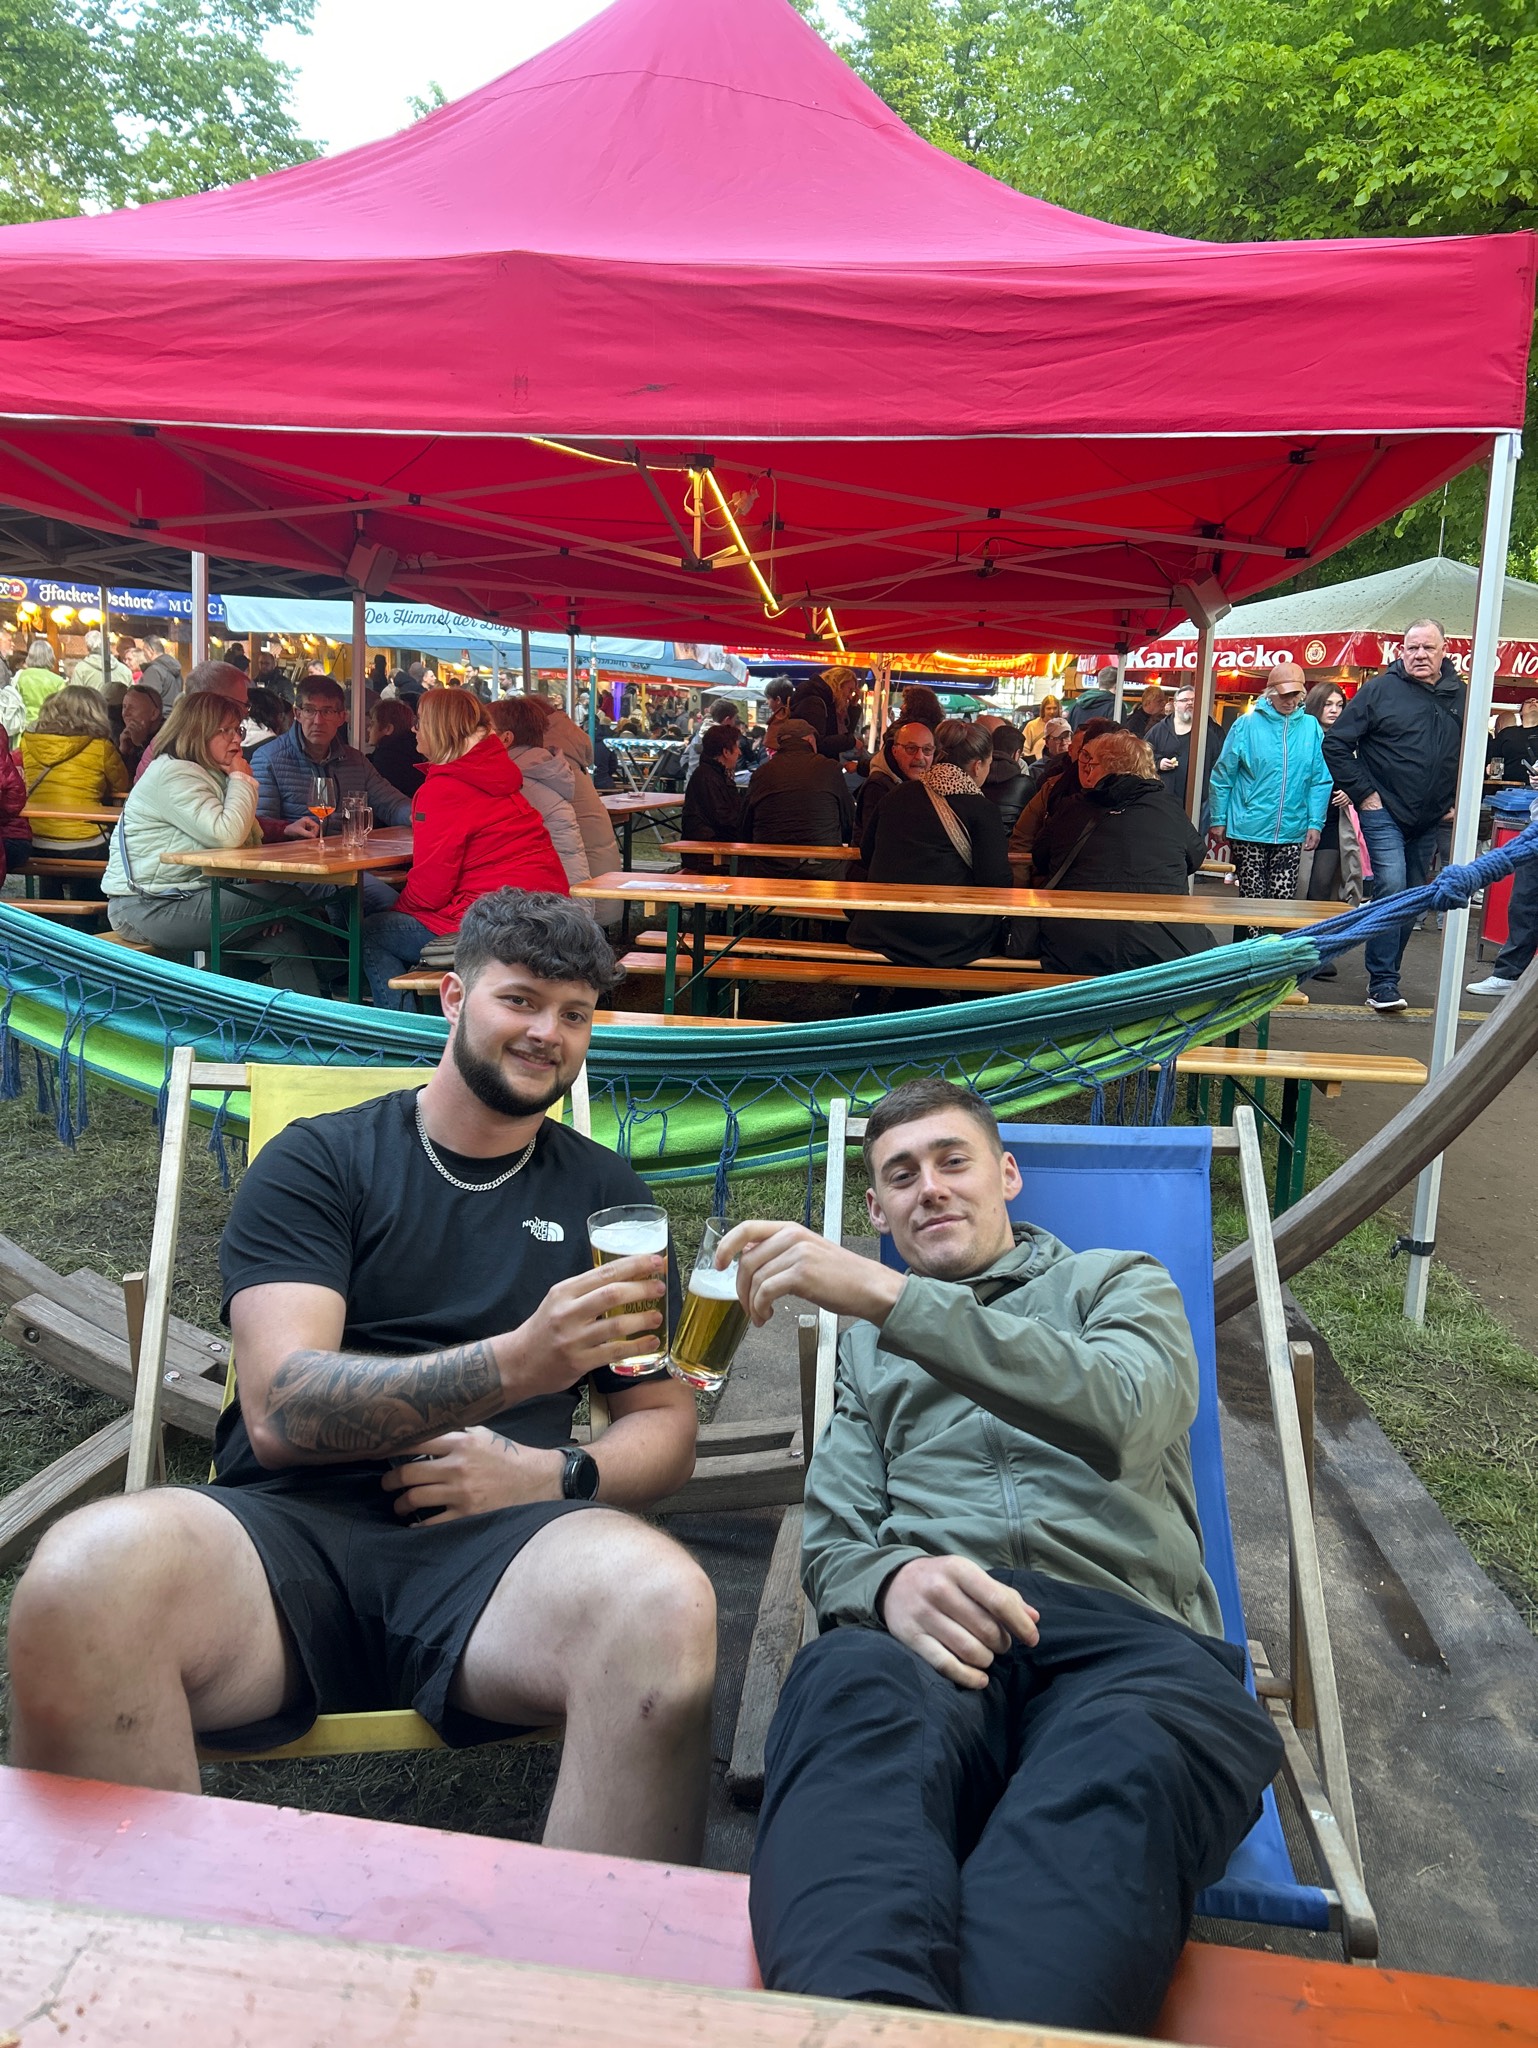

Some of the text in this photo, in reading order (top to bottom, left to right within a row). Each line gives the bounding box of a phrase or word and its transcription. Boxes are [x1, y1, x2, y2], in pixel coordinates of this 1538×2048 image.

[365, 608, 390, 624] Der
[393, 609, 451, 626] Himmel
[453, 615, 478, 628] der
[522, 1220, 548, 1235] NORTH
[530, 1227, 548, 1242] FACE
